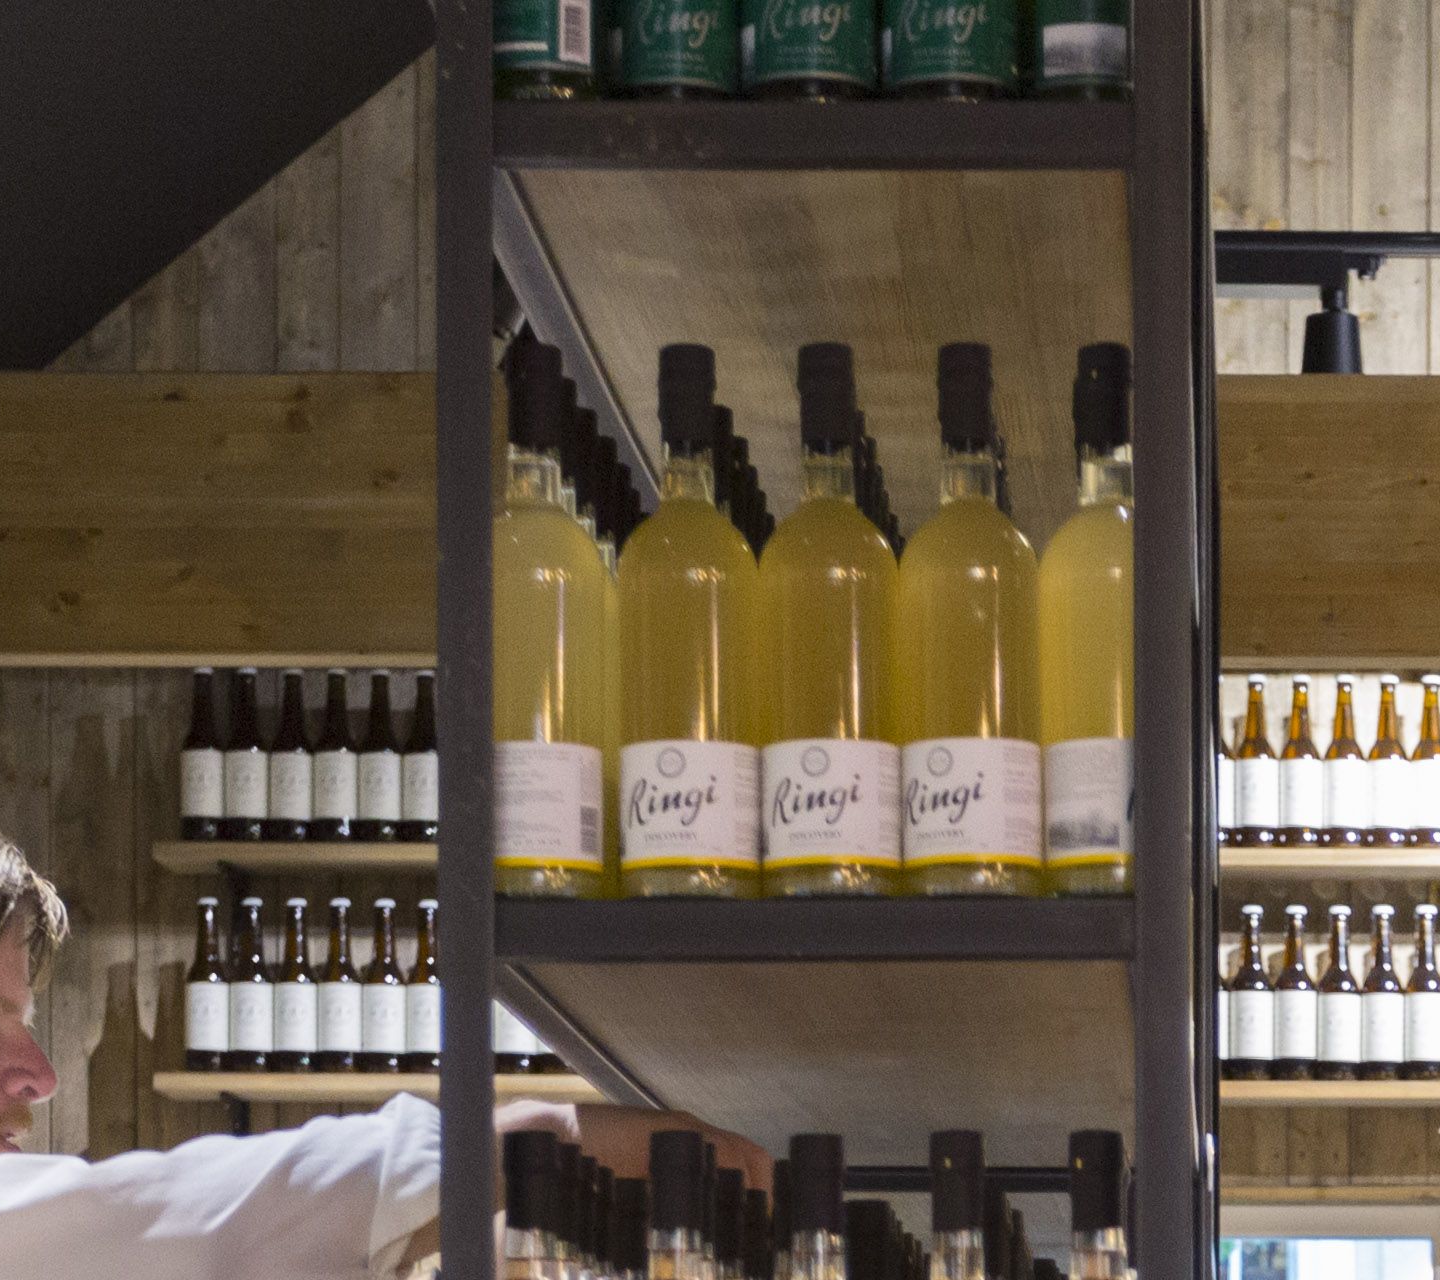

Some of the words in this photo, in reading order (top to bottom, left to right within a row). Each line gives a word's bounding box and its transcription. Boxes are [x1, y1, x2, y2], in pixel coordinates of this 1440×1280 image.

[629, 774, 717, 829] Ringi
[772, 772, 861, 828] Ringi
[905, 770, 985, 826] Ringi
